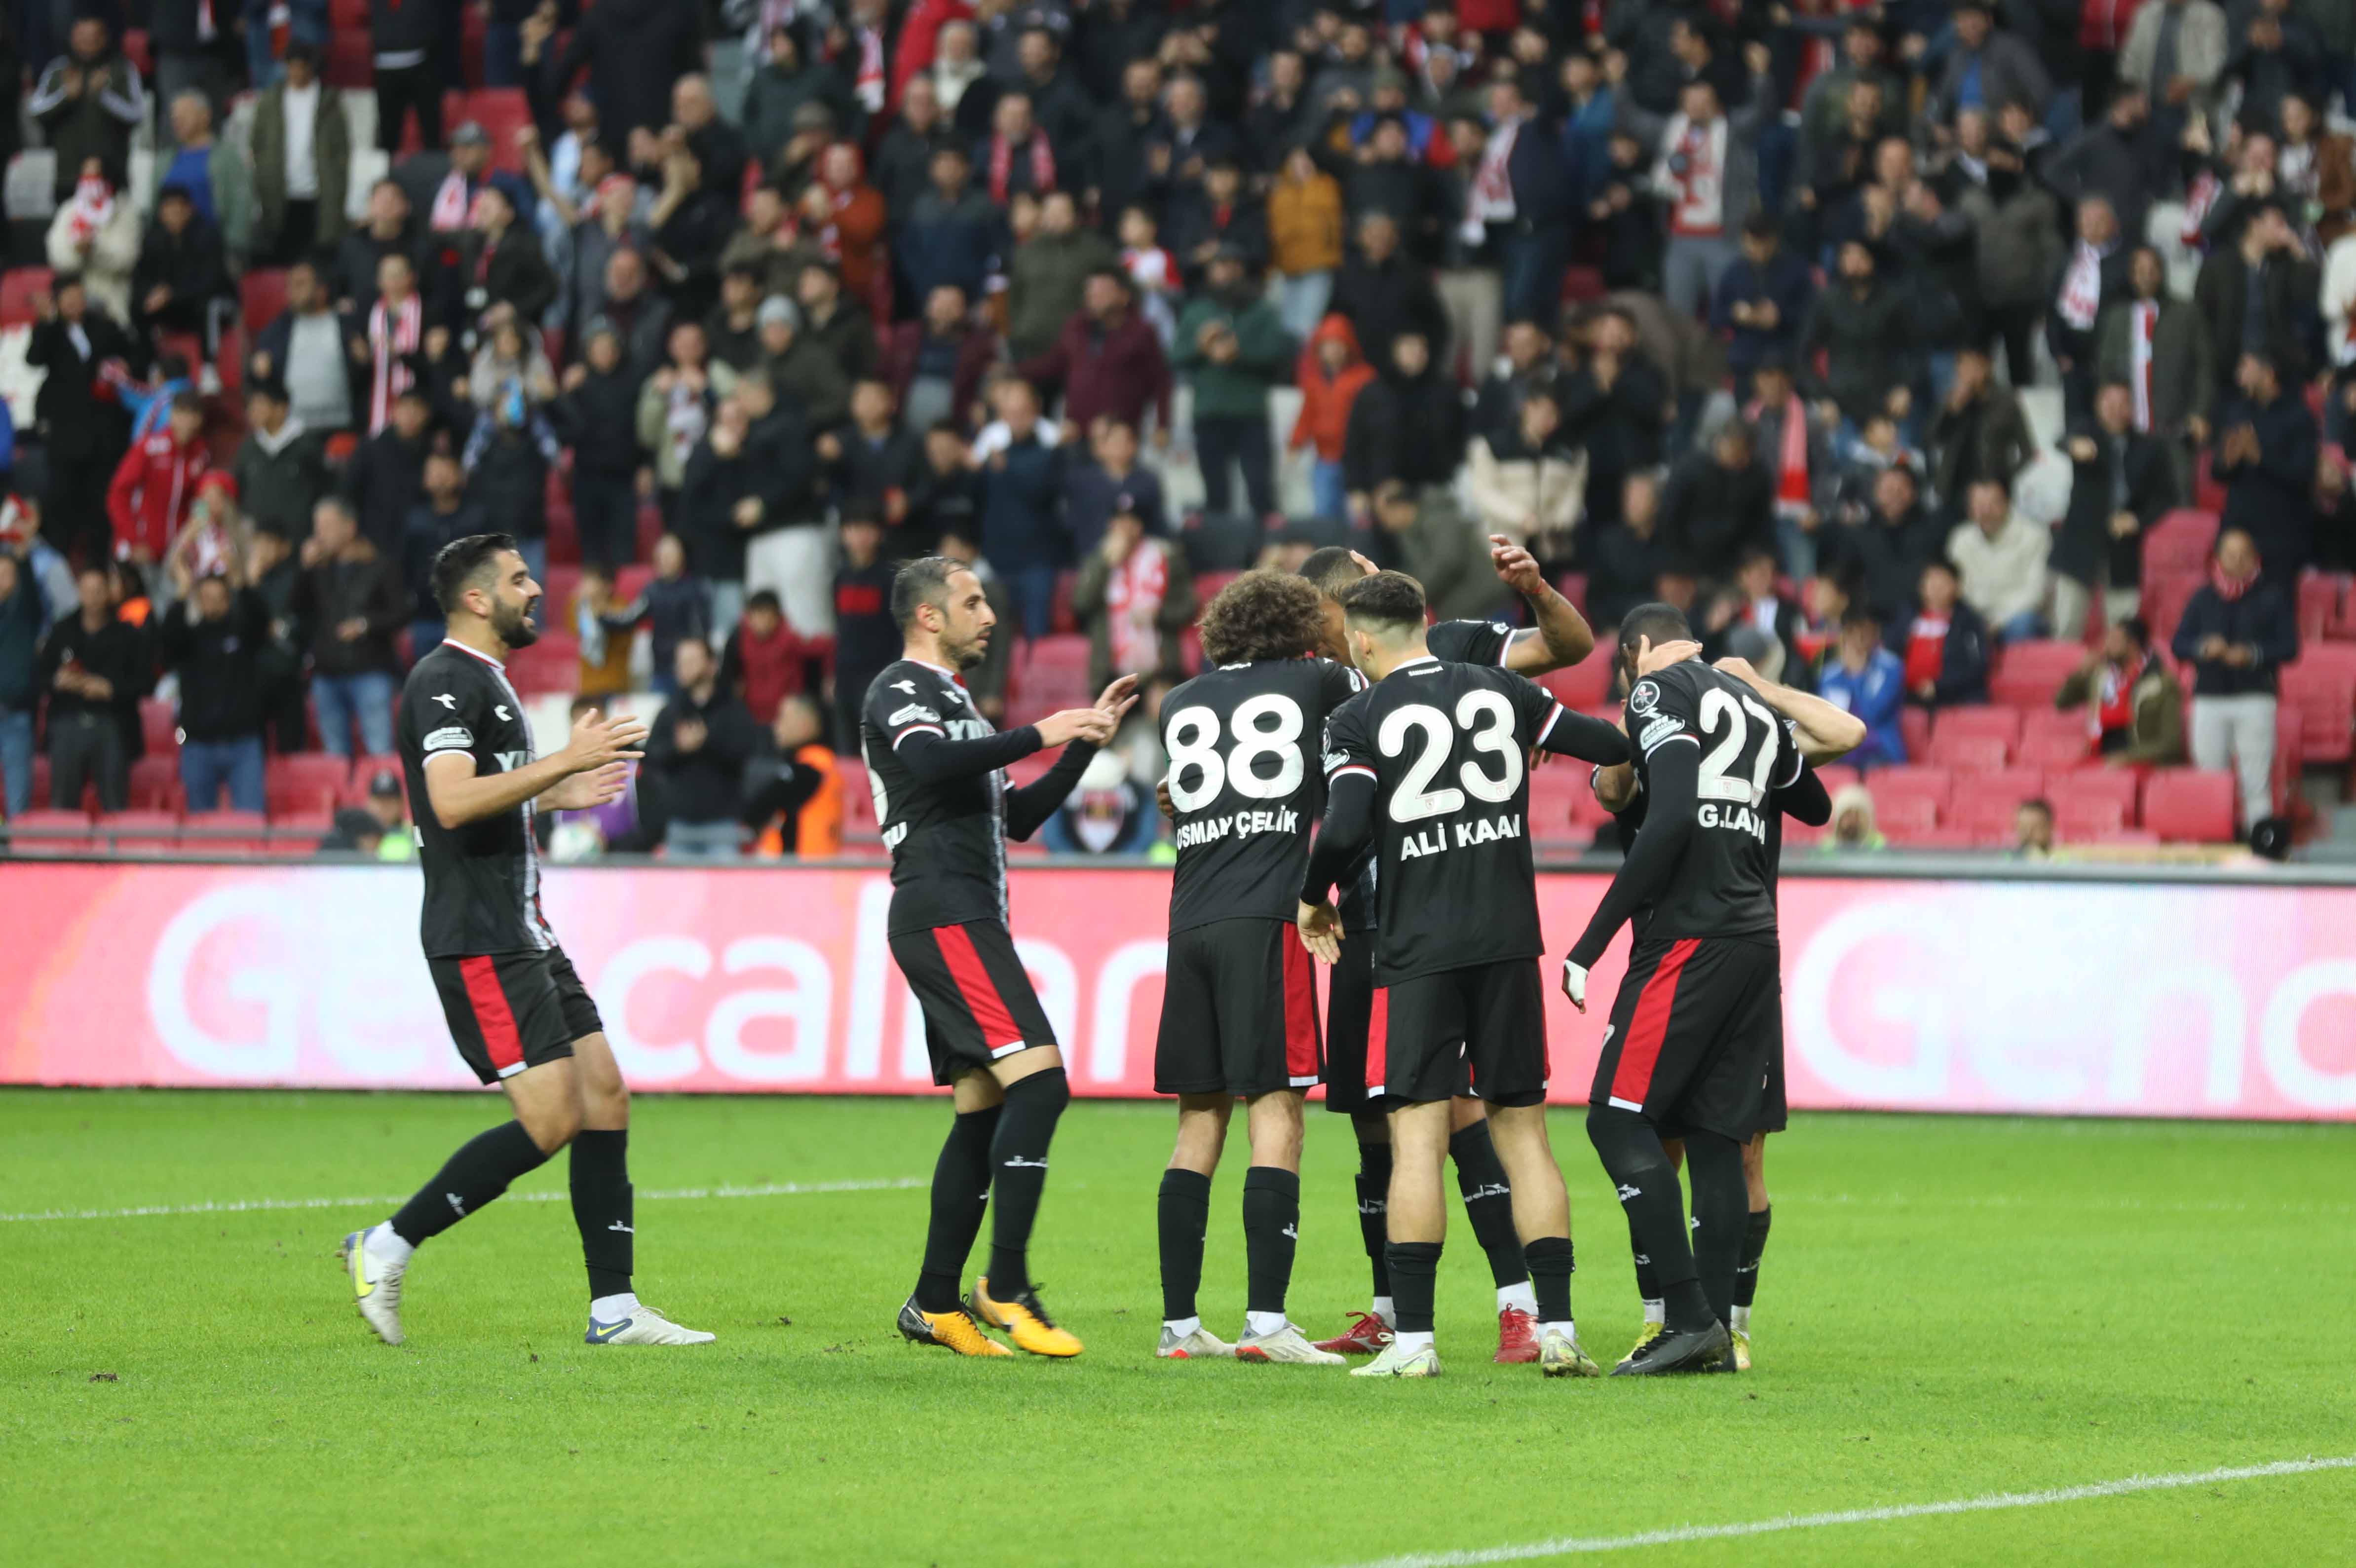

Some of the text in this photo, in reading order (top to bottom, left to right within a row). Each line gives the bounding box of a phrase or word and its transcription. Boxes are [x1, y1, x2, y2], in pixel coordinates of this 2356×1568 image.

[1166, 693, 1304, 813] 88
[1378, 688, 1523, 823] 23
[1235, 805, 1299, 839] ÇELİK
[1401, 822, 1447, 861] ALİ
